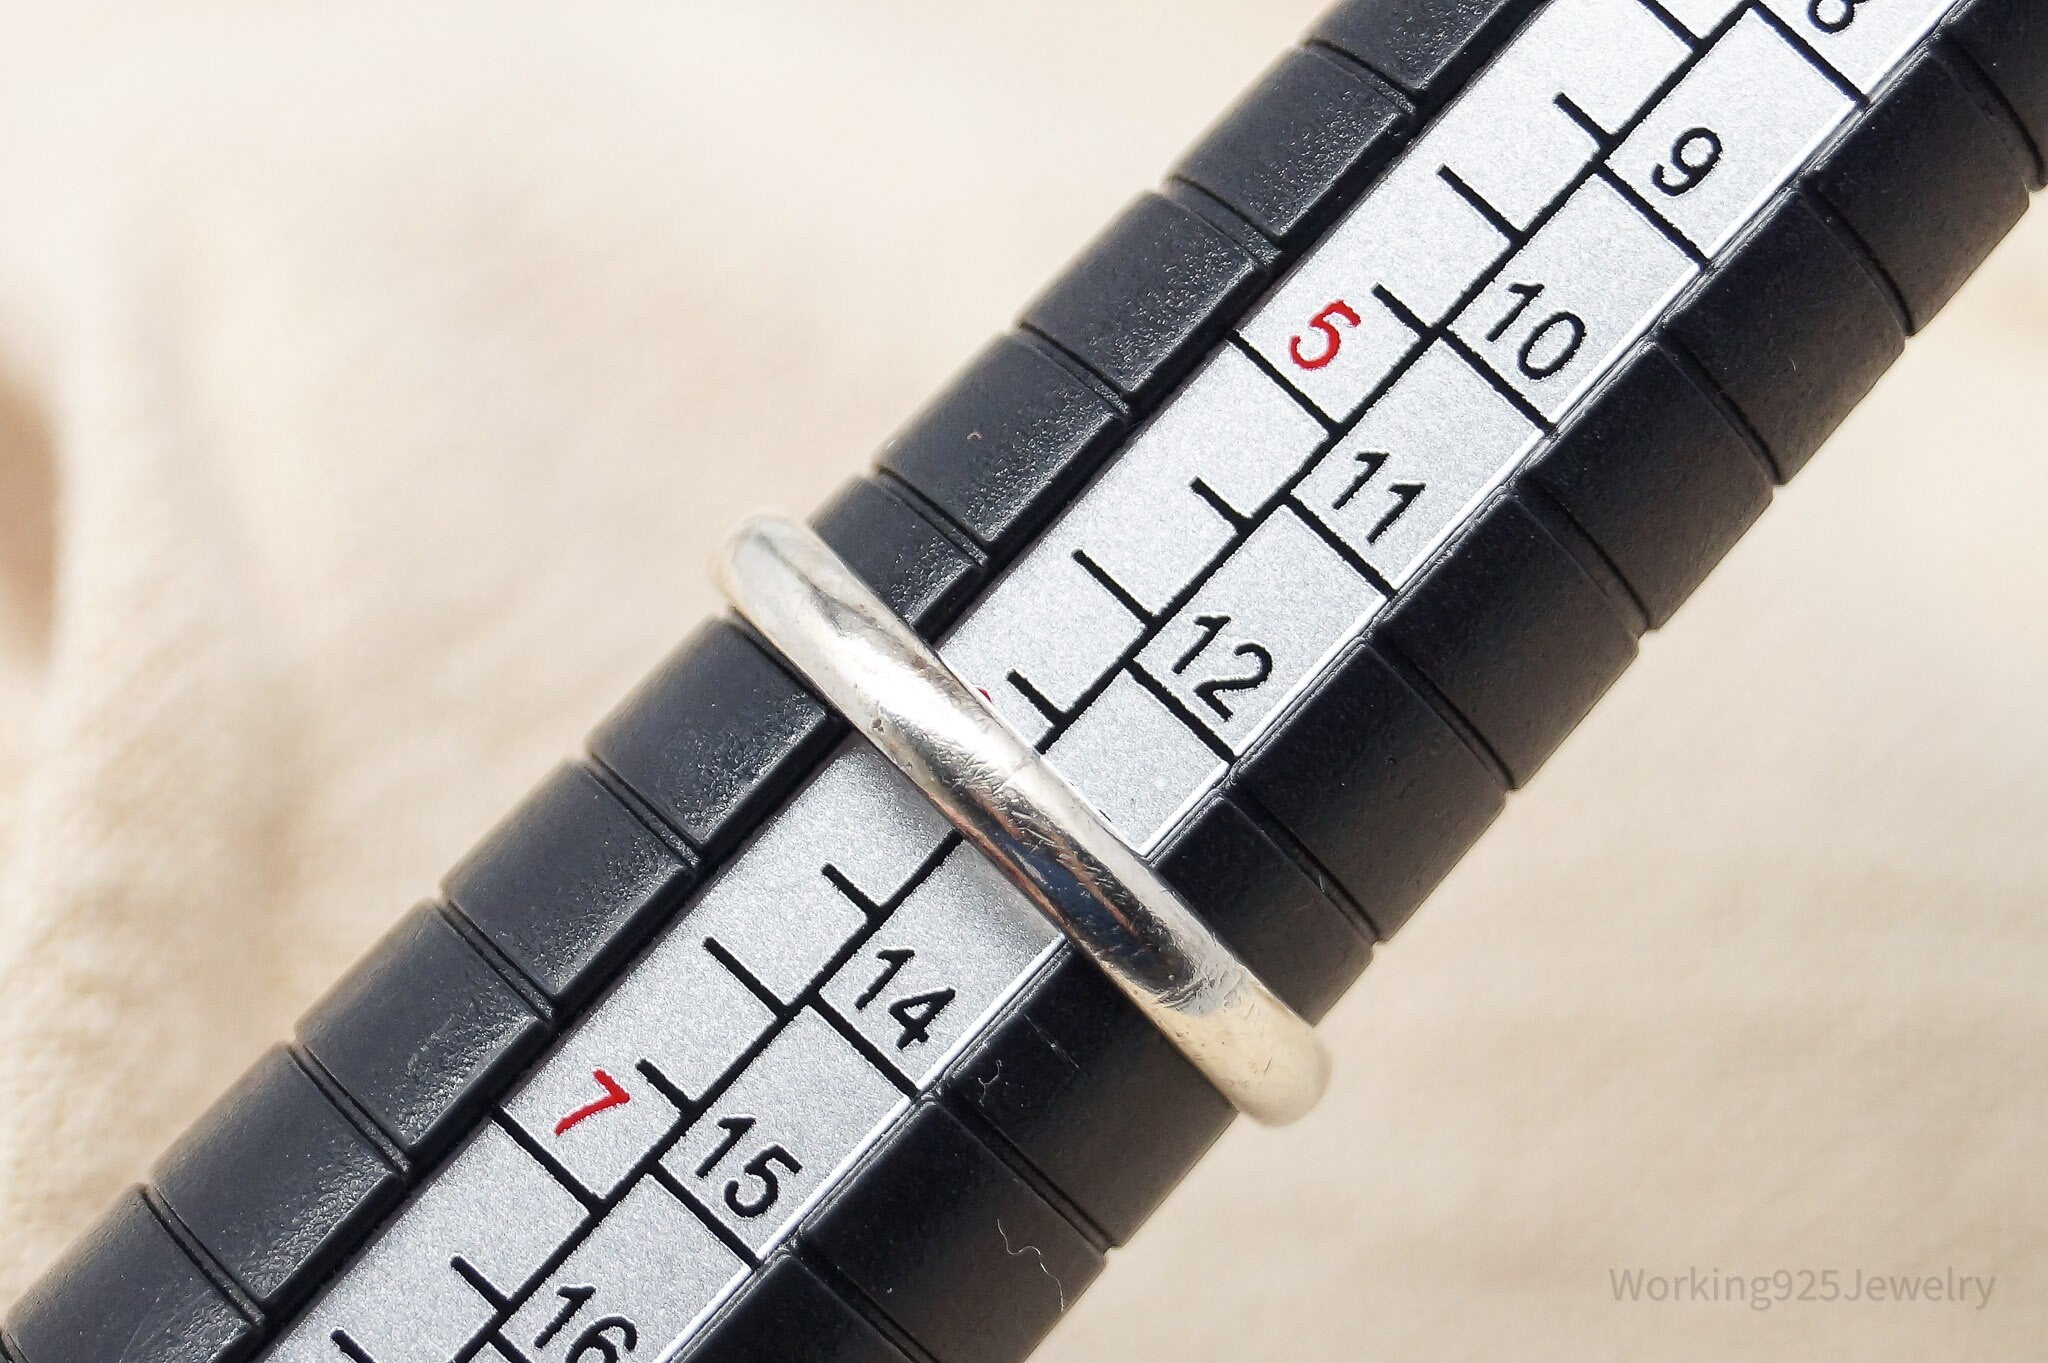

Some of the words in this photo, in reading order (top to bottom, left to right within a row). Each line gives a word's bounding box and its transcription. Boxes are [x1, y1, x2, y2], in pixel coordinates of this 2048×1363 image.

[1651, 127, 1724, 197] 9
[1288, 298, 1362, 371] 5
[1500, 282, 1588, 382] 10
[1332, 451, 1428, 546] 11
[1171, 614, 1274, 723] 12
[854, 948, 957, 1053] 14
[553, 1069, 631, 1136] 7
[695, 1116, 804, 1220] 15
[533, 1285, 640, 1363] 16
